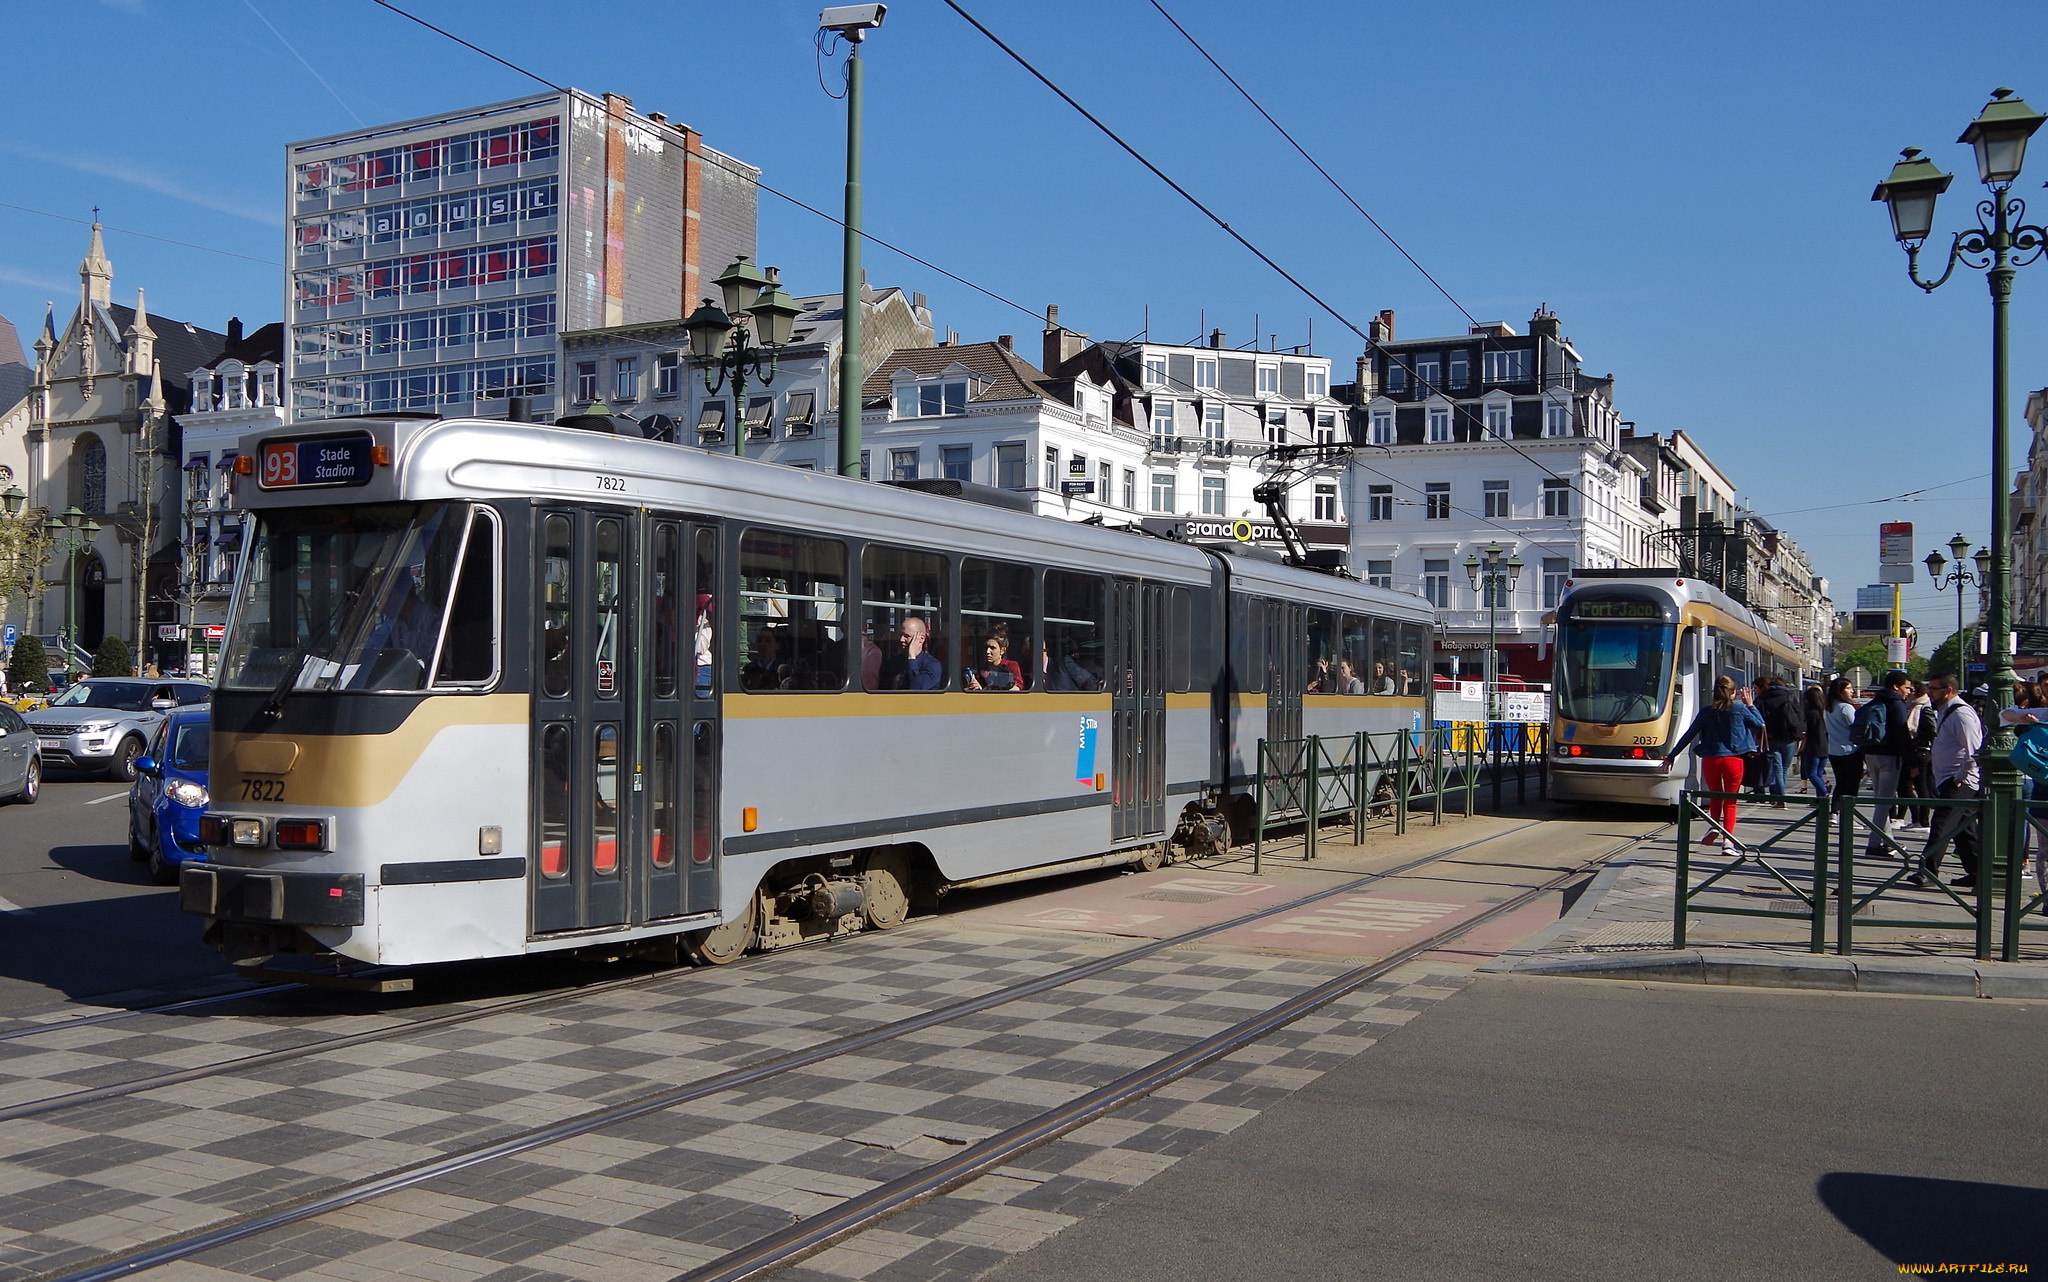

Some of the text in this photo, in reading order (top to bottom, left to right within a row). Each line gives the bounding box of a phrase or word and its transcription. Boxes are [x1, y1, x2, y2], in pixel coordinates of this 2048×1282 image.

[341, 190, 545, 237] daoust
[267, 447, 350, 482] 93 Stade
[315, 464, 355, 478] Stadion
[596, 476, 626, 491] 7822
[1581, 601, 1654, 617] Fort-Jaco
[7, 627, 15, 638] P
[1086, 718, 1098, 729] STIB
[1633, 736, 1658, 745] 2037
[241, 779, 286, 802] 7822
